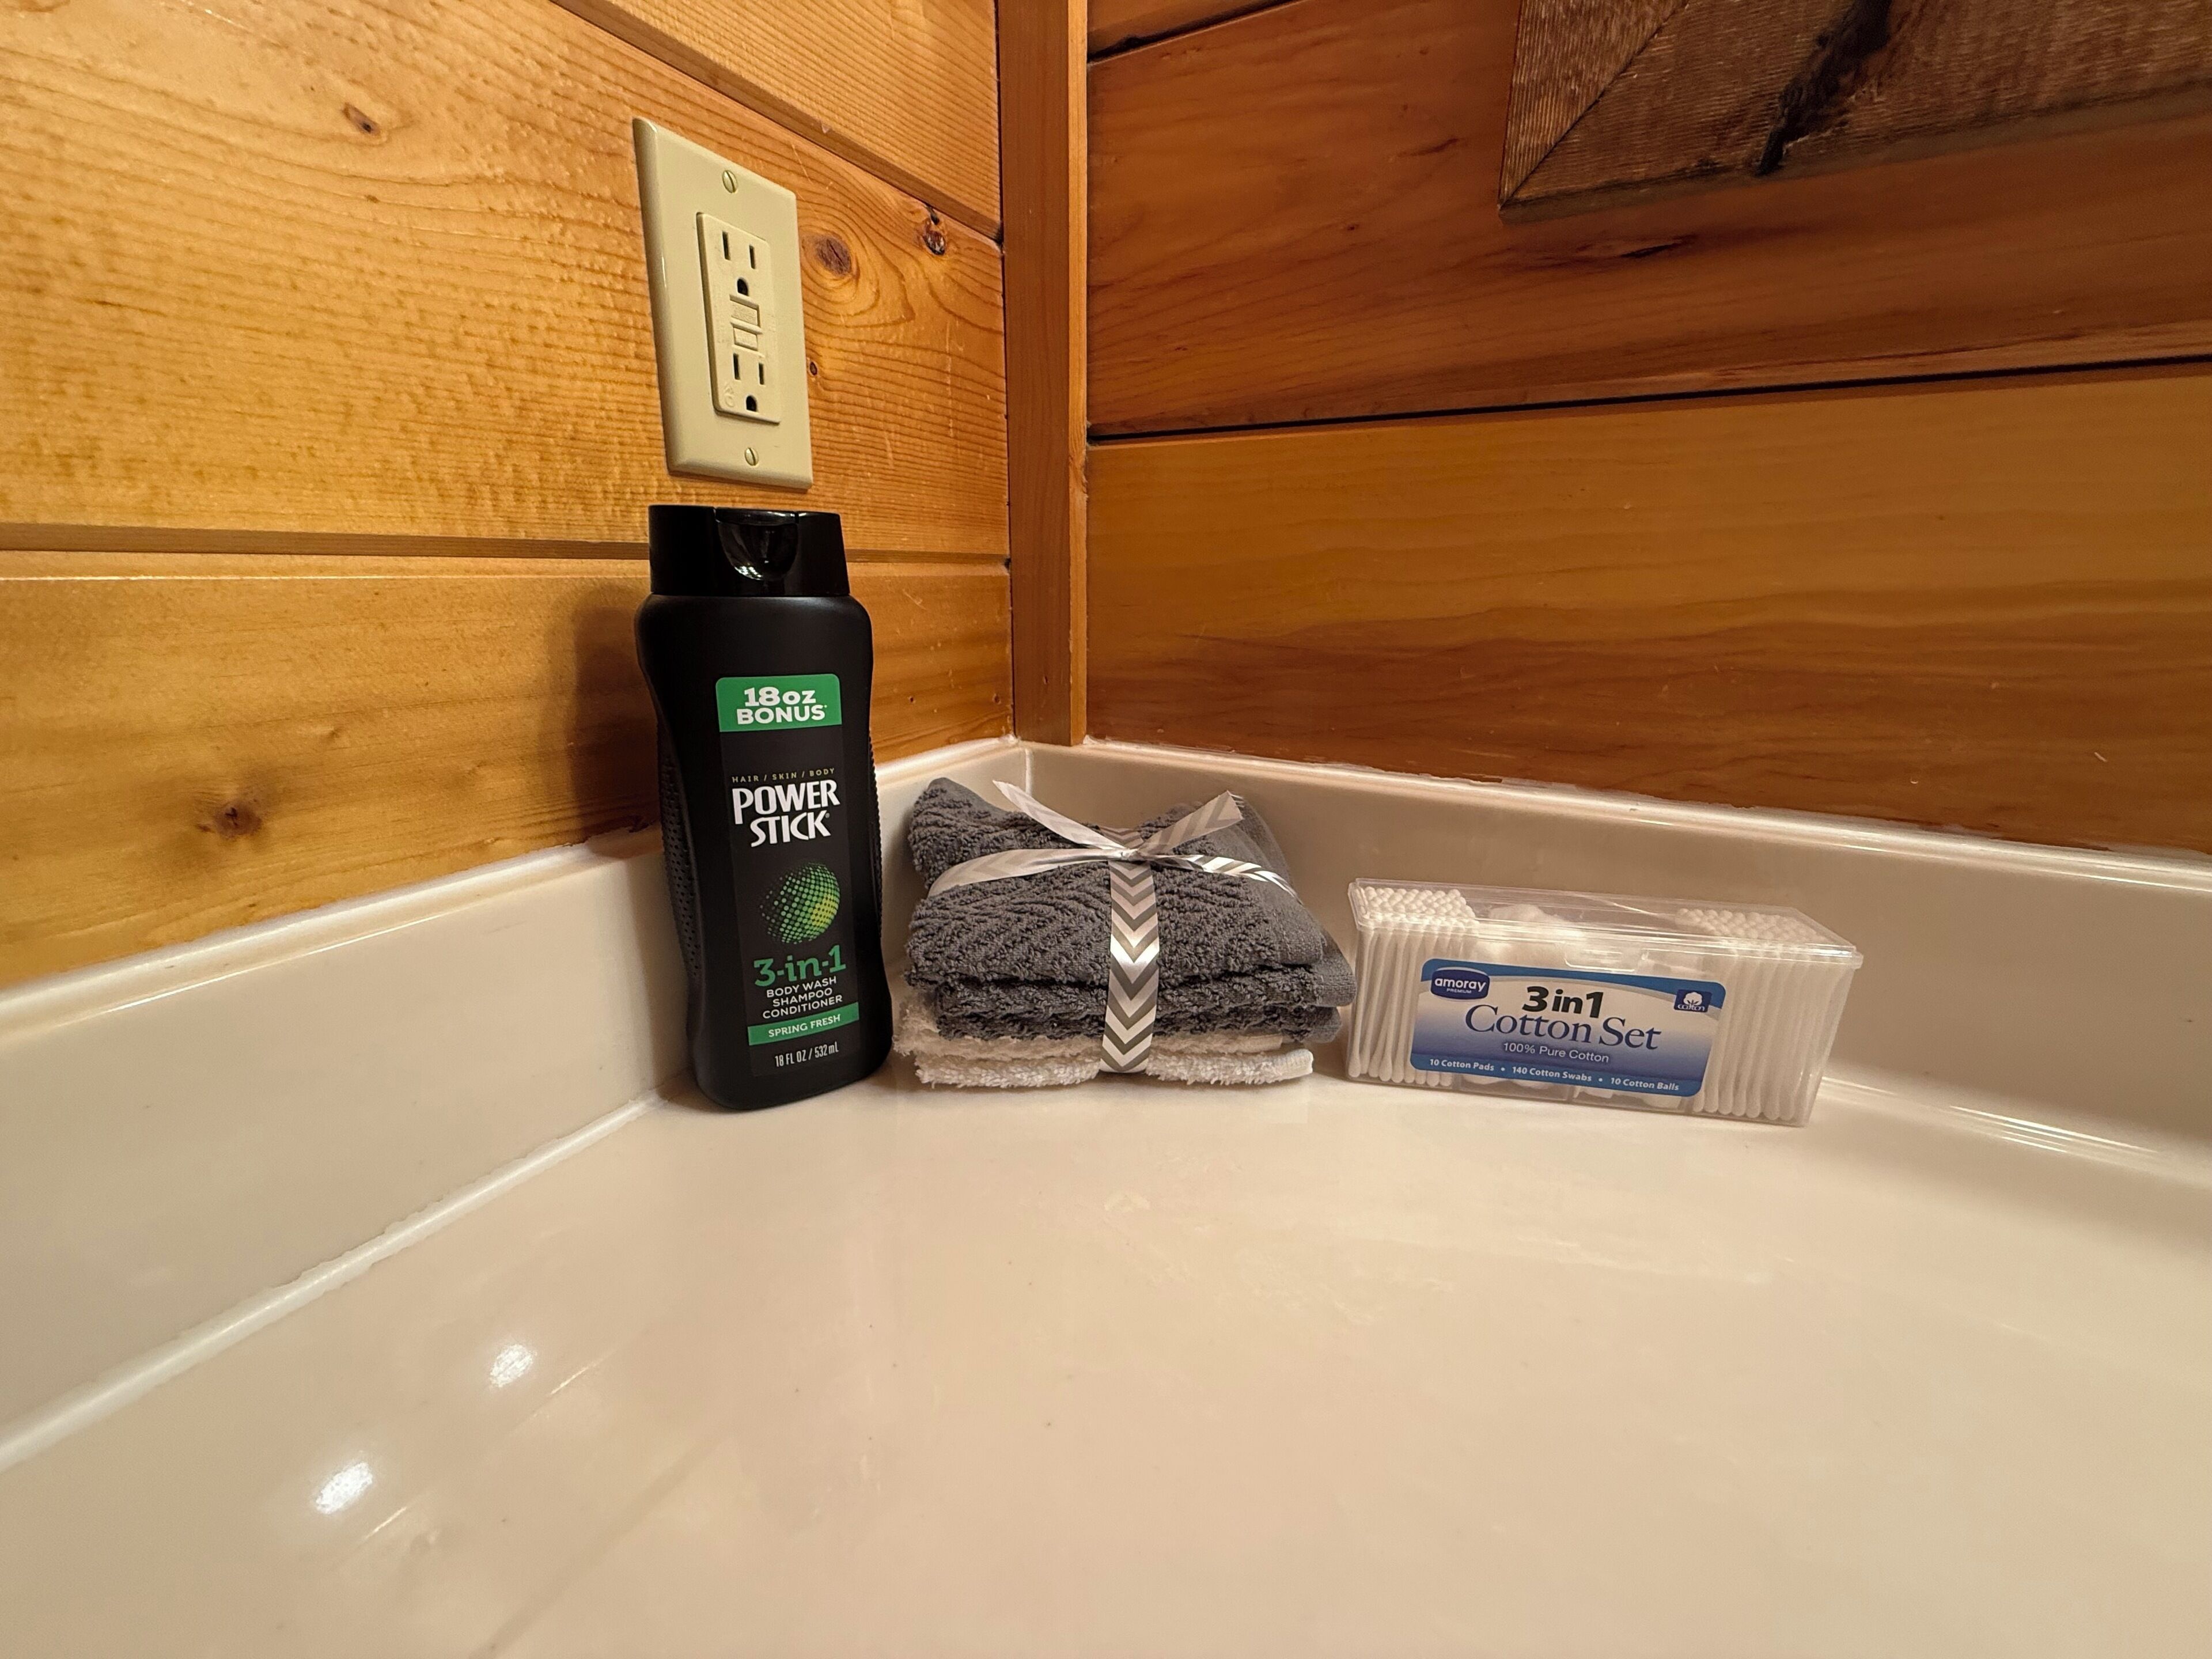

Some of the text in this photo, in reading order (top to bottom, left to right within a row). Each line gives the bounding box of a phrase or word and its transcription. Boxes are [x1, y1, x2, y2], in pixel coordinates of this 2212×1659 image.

[772, 772, 797, 781] SKIN
[809, 768, 835, 777] BODY
[732, 779, 840, 824] POWER
[750, 810, 831, 847] STICK
[753, 945, 846, 987] 3-in-1
[766, 976, 836, 998] BODY WASH
[1434, 978, 1486, 992] amoray
[763, 995, 843, 1019] CONDITIONER
[772, 987, 832, 1007] SHAMPOO
[768, 1014, 841, 1037] SPRING FRESH
[1465, 1005, 1661, 1050] Cotton Set
[775, 1055, 784, 1067] 18
[786, 1052, 794, 1065] FL
[796, 1050, 806, 1063] OZ
[1503, 1043, 1609, 1063] 100% Pure Cotton
[1441, 1059, 1471, 1068] Cotton
[1473, 1062, 1494, 1071] Pads
[1512, 1066, 1528, 1074] 140
[1529, 1068, 1560, 1078] Cotton
[1562, 1071, 1592, 1082] Swabs
[1623, 1078, 1654, 1088] Cotton
[1657, 1082, 1679, 1090] Balls
